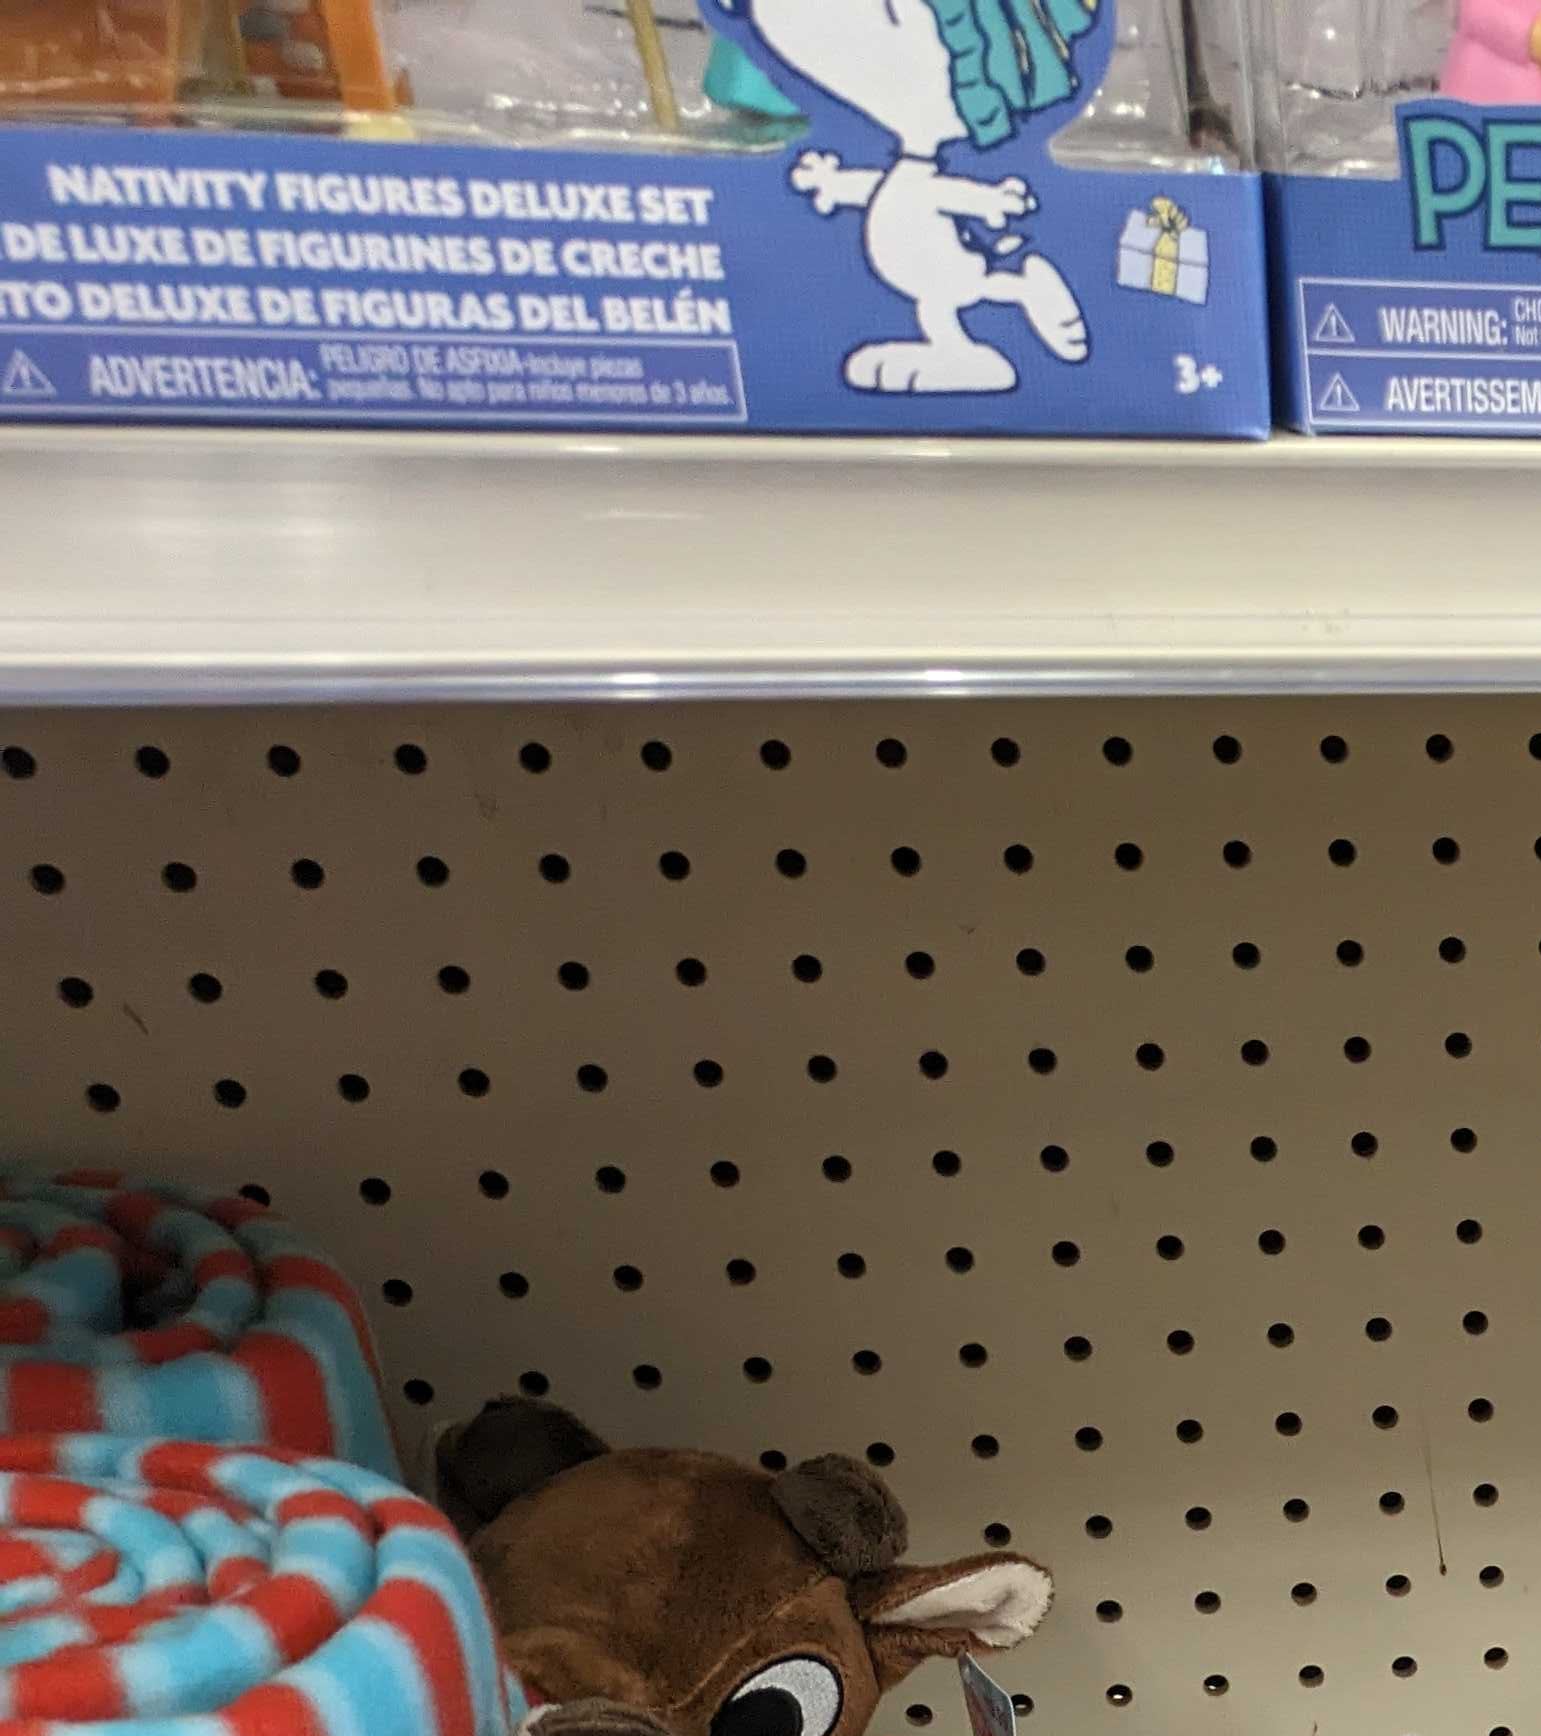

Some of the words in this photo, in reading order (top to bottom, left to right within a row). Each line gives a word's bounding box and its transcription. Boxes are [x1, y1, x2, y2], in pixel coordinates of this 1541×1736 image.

[46, 164, 268, 210] NATIVITY
[273, 171, 466, 218] FIGURES
[467, 178, 635, 222] DELUXE
[639, 187, 713, 226] SET
[2, 221, 66, 262] DE
[68, 223, 189, 265] LUXE
[190, 227, 256, 267] DE
[257, 230, 496, 275] FIGURINES
[497, 239, 558, 277] DE
[561, 239, 724, 280] CRECHE
[77, 281, 255, 323] DELUXE
[256, 286, 320, 325] DE
[322, 288, 514, 331] FIGURAS
[517, 295, 599, 332] DEL
[600, 286, 732, 334] BELÉN
[1379, 305, 1508, 346] WARNING:
[1514, 326, 1538, 345] Not
[88, 352, 322, 400] ADVERTENCIA:
[1172, 353, 1223, 395] 3+
